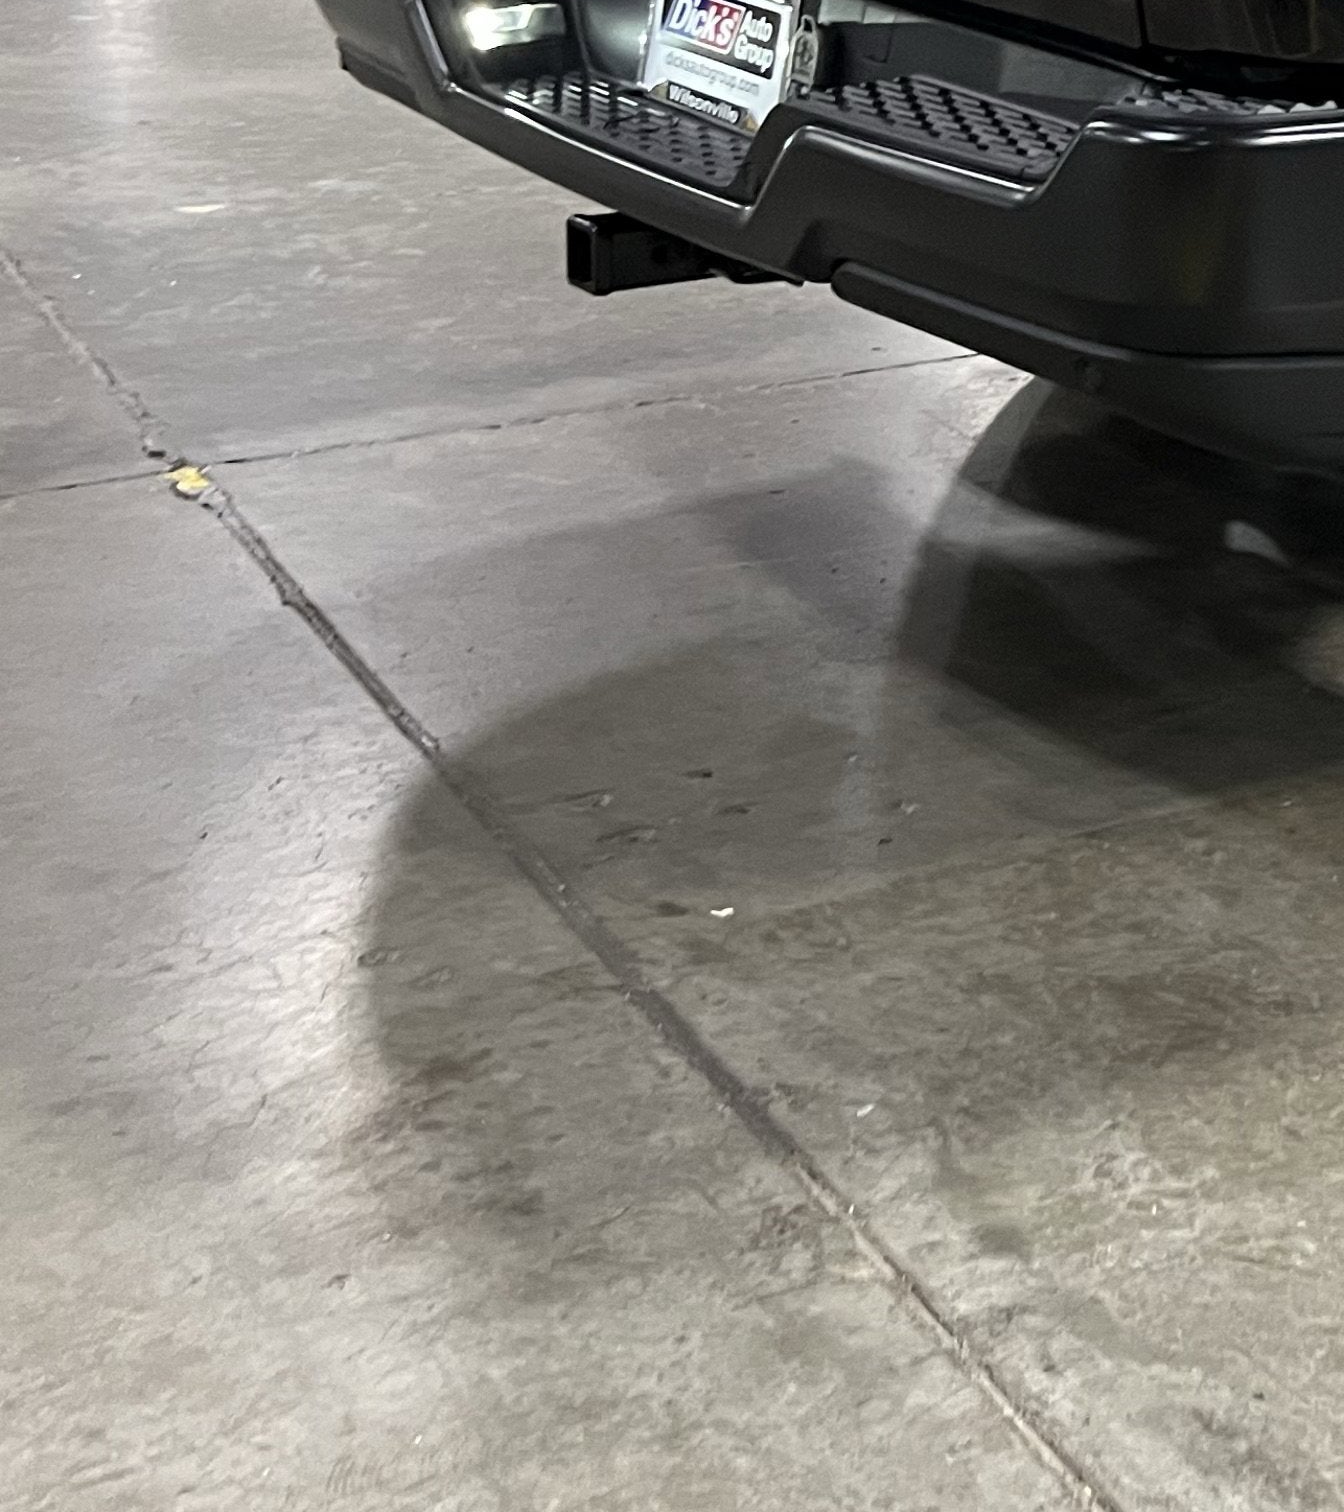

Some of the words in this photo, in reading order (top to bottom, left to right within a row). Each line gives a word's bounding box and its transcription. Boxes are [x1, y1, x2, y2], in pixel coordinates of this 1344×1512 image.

[740, 10, 774, 43] Auto
[734, 35, 775, 73] Group
[668, 84, 740, 124] Wilsonville
